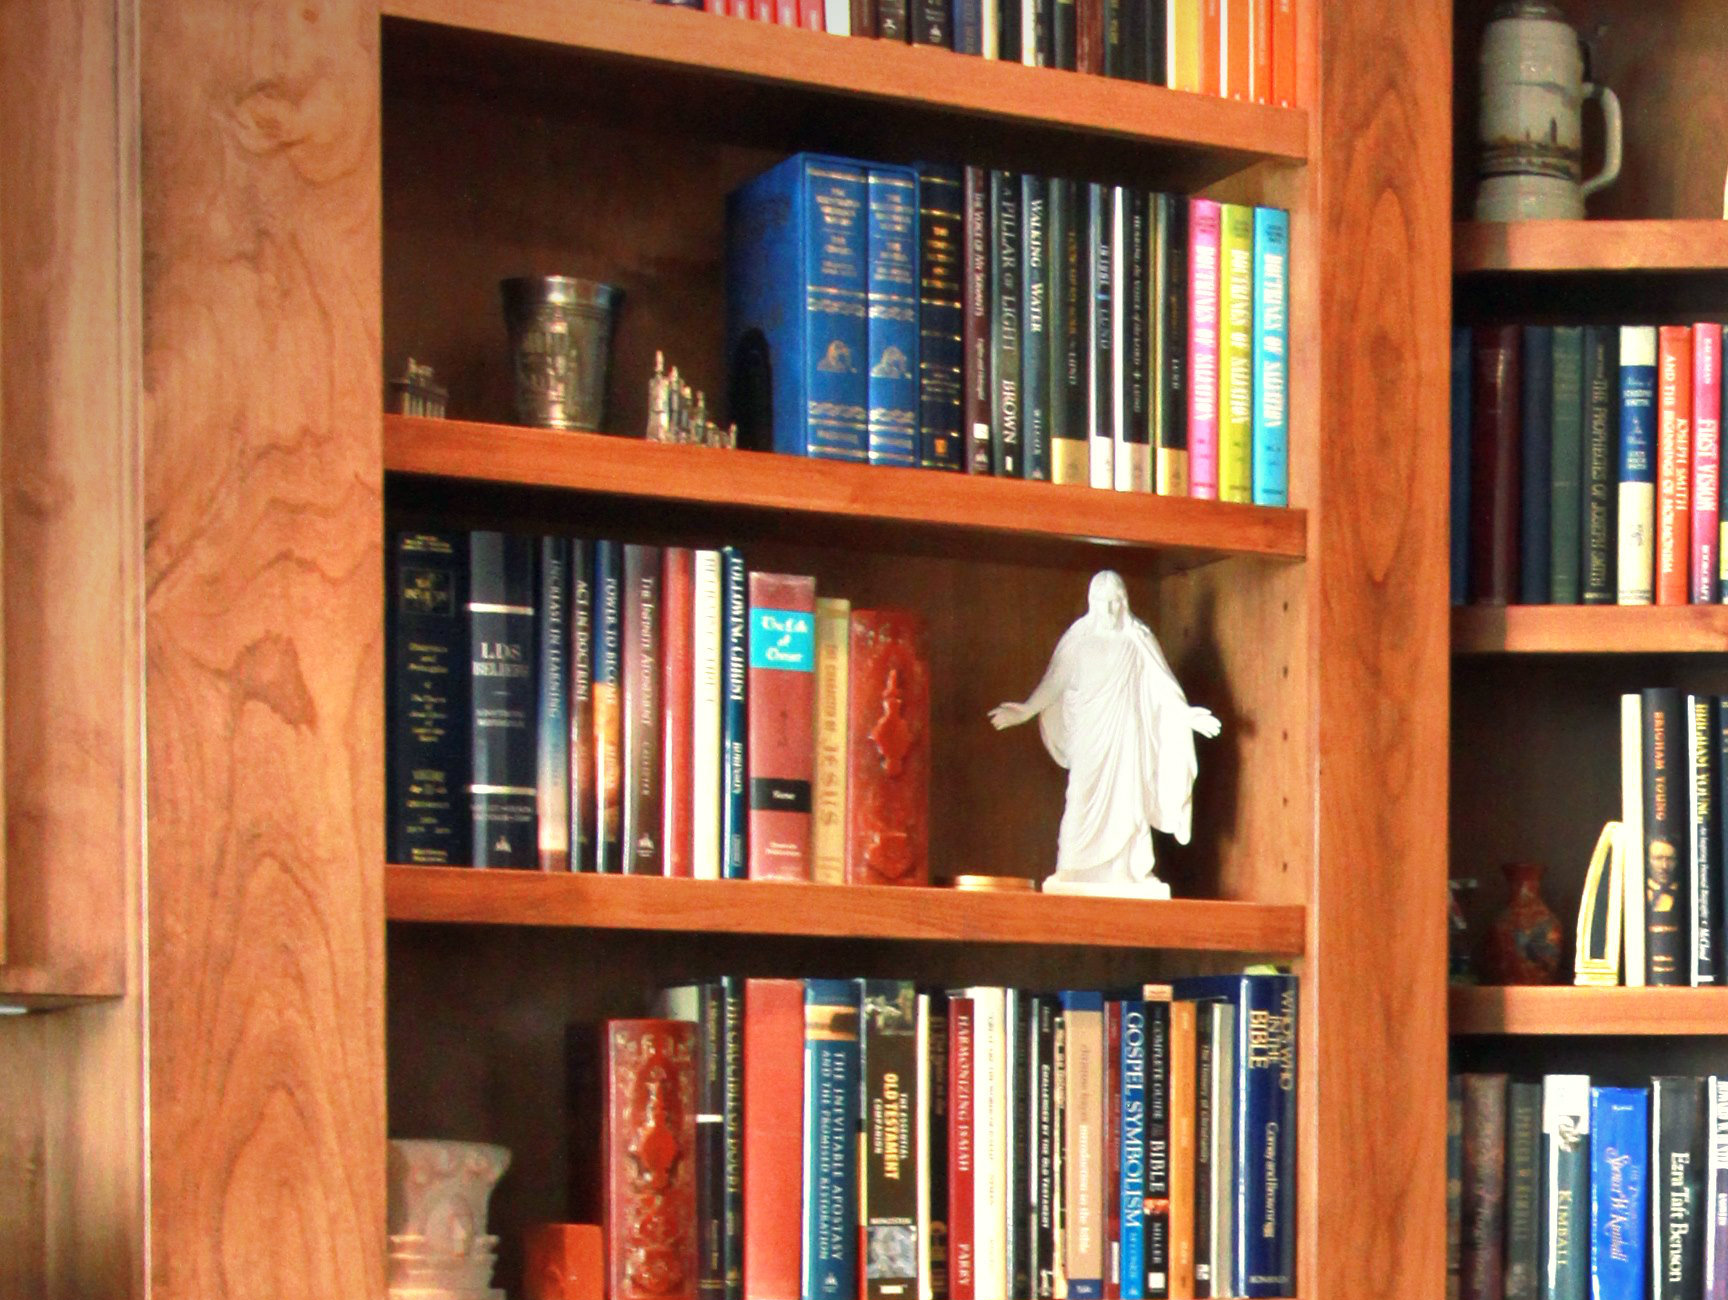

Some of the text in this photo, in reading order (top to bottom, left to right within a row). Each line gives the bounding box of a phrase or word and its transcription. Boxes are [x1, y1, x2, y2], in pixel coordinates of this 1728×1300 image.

[1002, 201, 1018, 269] PILLAR
[1030, 200, 1044, 333] WALKING WATER
[1002, 295, 1018, 356] LIGHT
[1662, 354, 1675, 381] AND
[1662, 384, 1675, 407] THE
[1002, 379, 1017, 445] BROWN
[1662, 480, 1675, 496] OF
[1676, 418, 1687, 511] JOSEPH SMITH
[1695, 419, 1717, 511] FIRST VISION
[605, 577, 618, 625] POWER
[729, 557, 744, 644] FOLLOWING
[548, 629, 562, 645] IN
[575, 580, 589, 702] ACT IN DOCTRINE
[605, 630, 618, 648] TO
[641, 577, 655, 727] THE INFINITE ATONEMENT
[1654, 711, 1666, 821] BRIGHAM YOUNG
[1696, 703, 1709, 768] BRIGHAM
[818, 1050, 832, 1077] AND
[957, 1015, 970, 1121] HARMONIZING
[1125, 1012, 1144, 1097] GOSPEL
[1249, 1010, 1269, 1070] BIBLE
[1268, 1015, 1281, 1065] IN THE
[1280, 1047, 1294, 1091] WHO
[818, 1082, 832, 1108] THE
[883, 1073, 899, 1180] OLD TESTAMENT
[832, 1051, 846, 1260] THE INEVITABLE APOSTASY
[1125, 1101, 1144, 1228] SYMBOLISM
[1148, 1140, 1166, 1193] BIBLE
[1152, 1222, 1164, 1264] MILLER
[1556, 1190, 1573, 1267] KIMBALL
[1669, 1152, 1690, 1283] Ezra Taft Benson
[958, 1243, 970, 1286] PARRY
